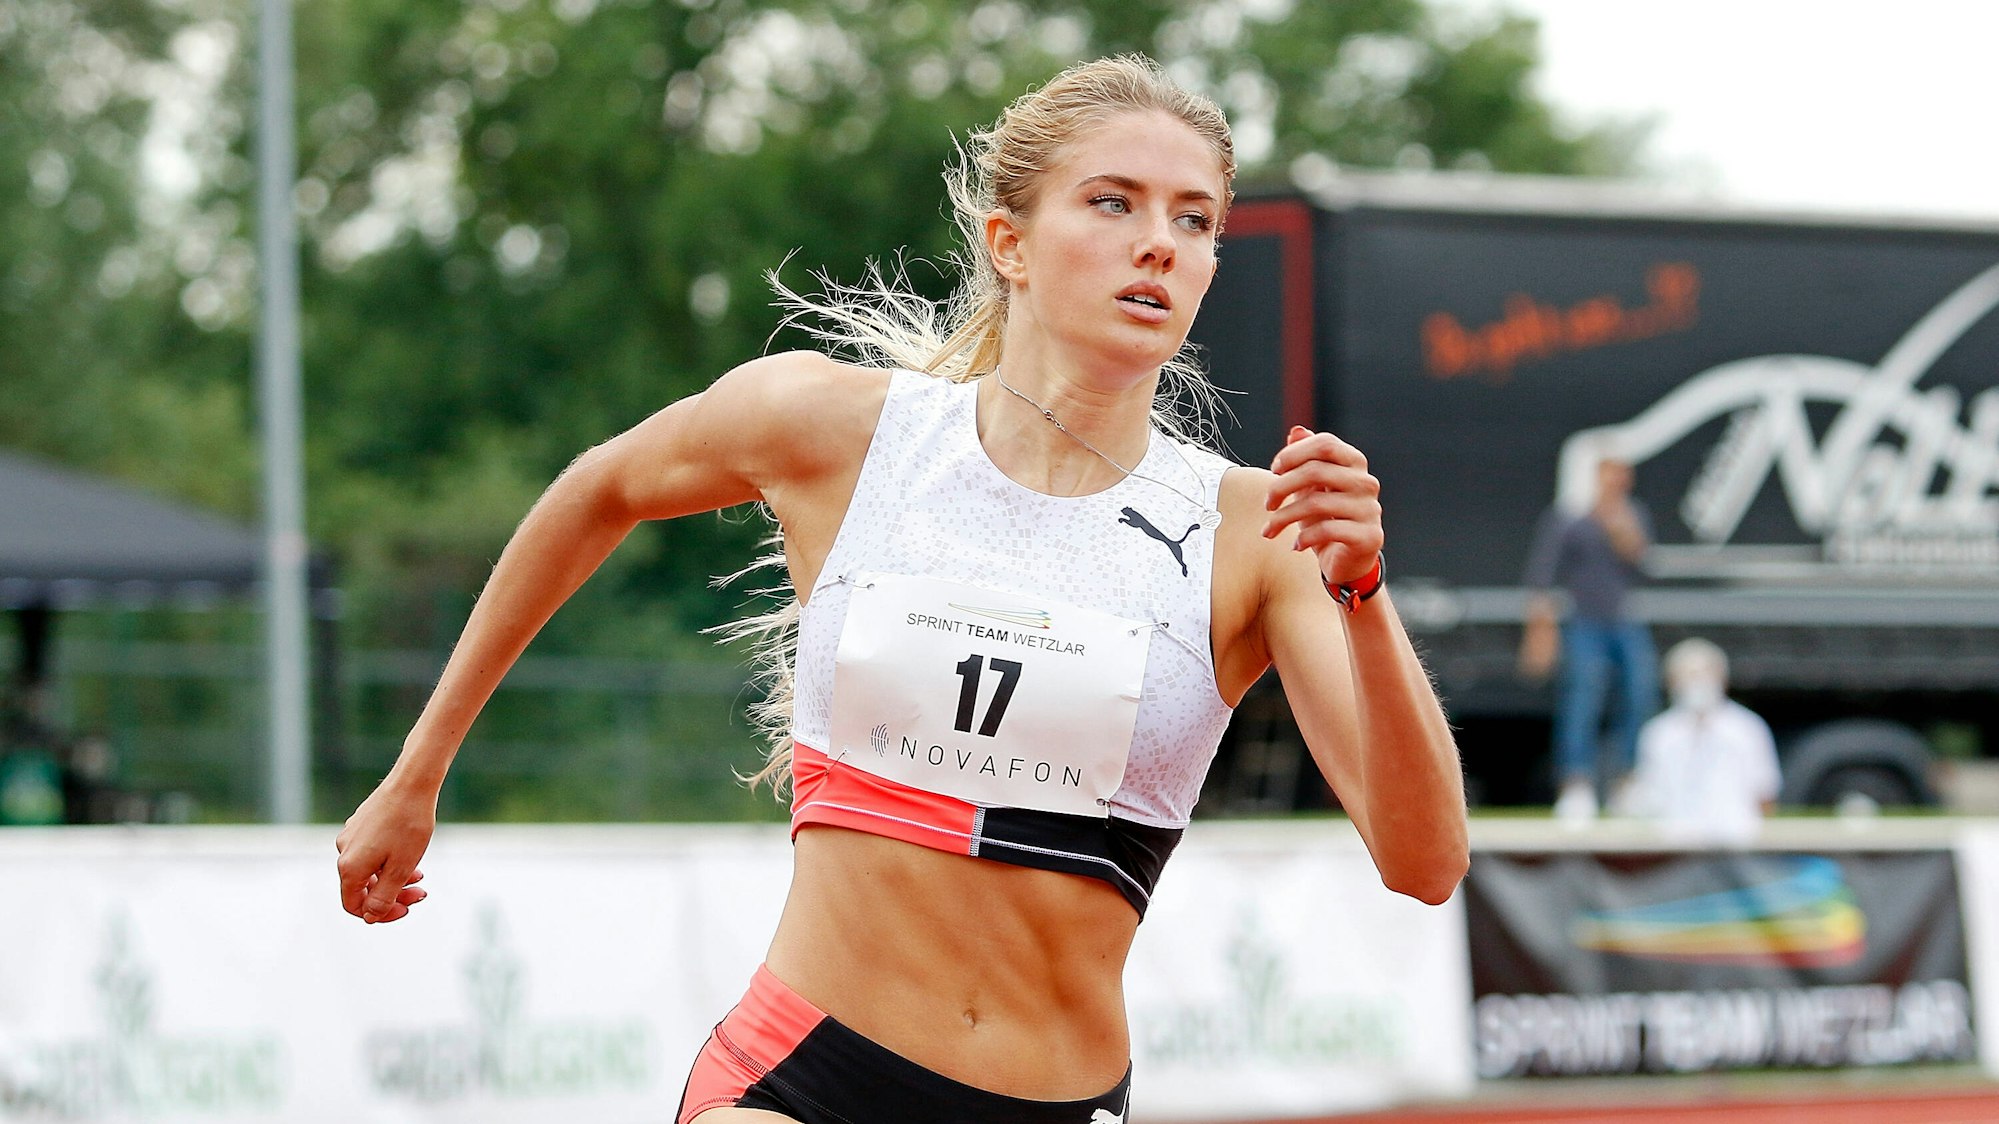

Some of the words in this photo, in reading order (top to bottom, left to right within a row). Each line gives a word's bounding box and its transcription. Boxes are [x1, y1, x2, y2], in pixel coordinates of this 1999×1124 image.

[906, 612, 963, 634] SPRINT
[966, 623, 1009, 642] TEAM
[1013, 632, 1086, 657] WETZLAR
[953, 653, 1023, 738] 17
[900, 735, 1083, 788] NOVAFON
